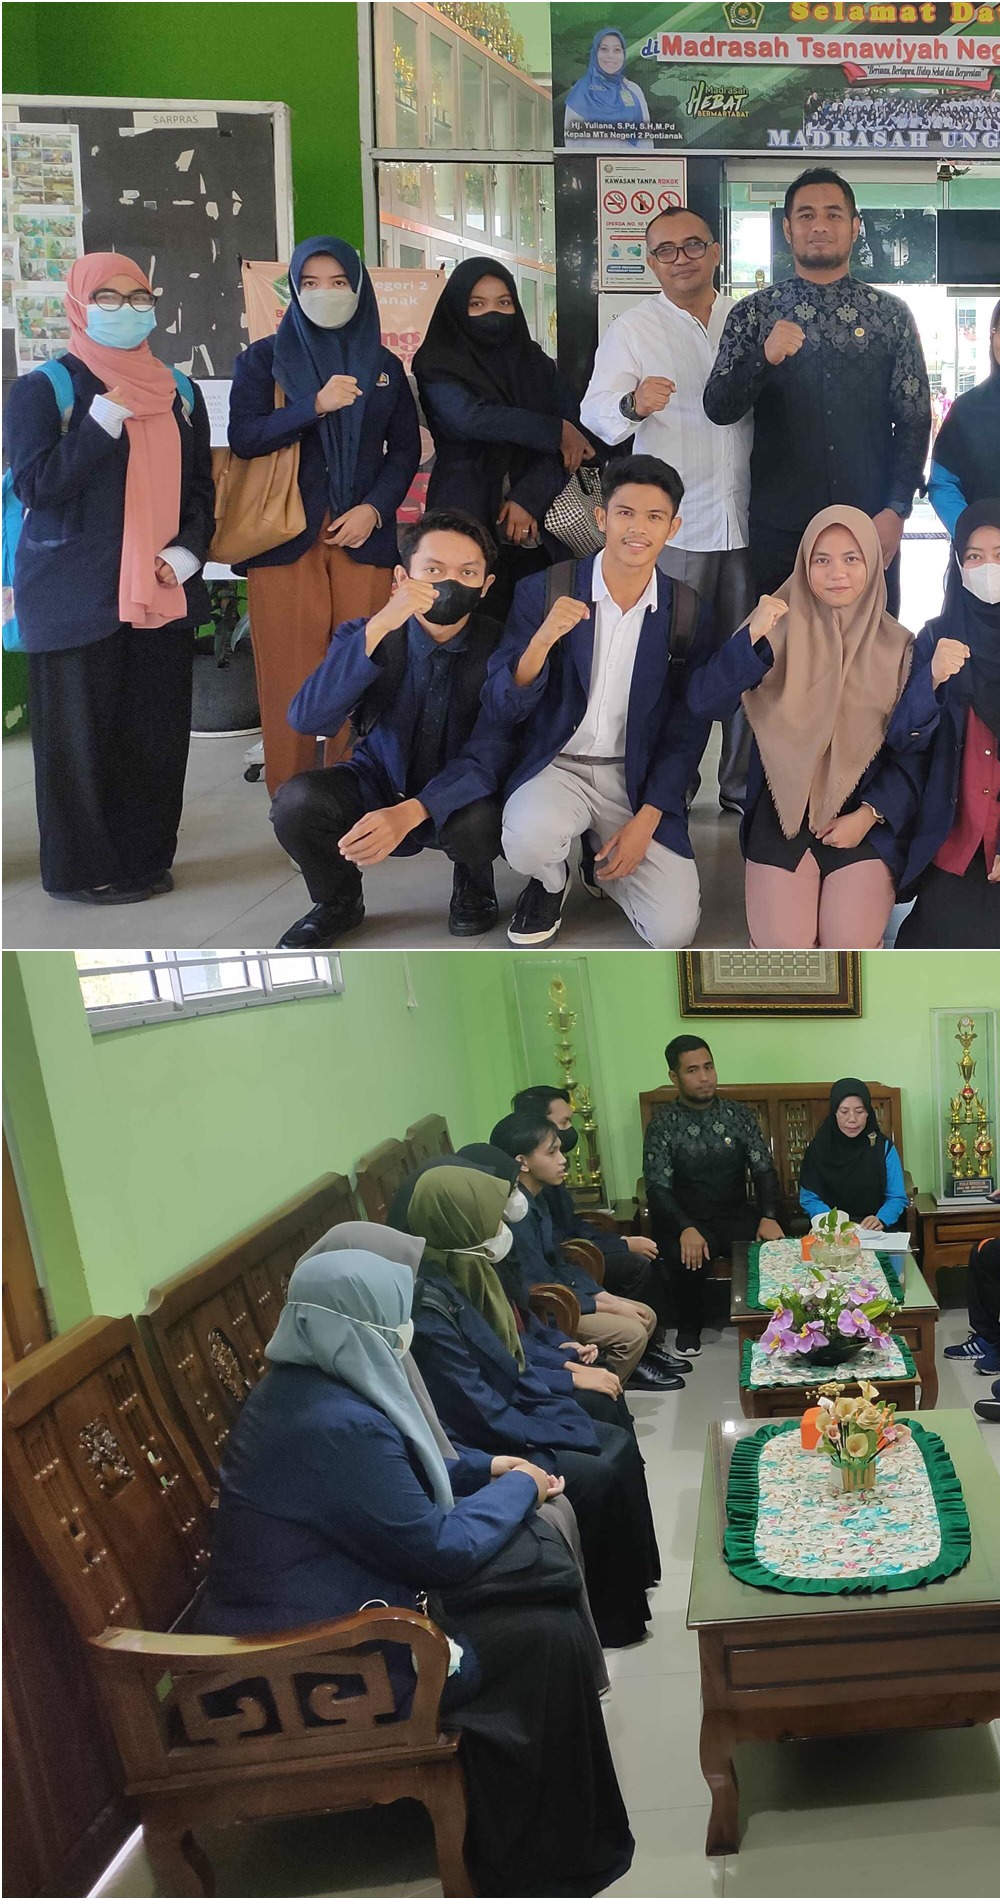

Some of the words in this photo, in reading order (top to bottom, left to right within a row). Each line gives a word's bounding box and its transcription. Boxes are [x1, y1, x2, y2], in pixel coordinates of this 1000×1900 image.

[791, 3, 936, 23] Selamat
[641, 38, 659, 57] di
[662, 35, 789, 58] Madrasah
[797, 37, 947, 63] Tsanawiyah
[705, 85, 749, 94] Madrasah
[687, 81, 748, 118] HEBAT
[153, 115, 199, 124] SARPRAS
[571, 122, 583, 130] Hj.
[584, 122, 616, 130] Yuliana,
[617, 123, 638, 131] S.Pd,
[564, 131, 591, 139] Kepala
[610, 132, 636, 140] Negeri
[766, 129, 929, 148] MADRASAH
[375, 281, 414, 292] egeri
[419, 281, 428, 291] 2
